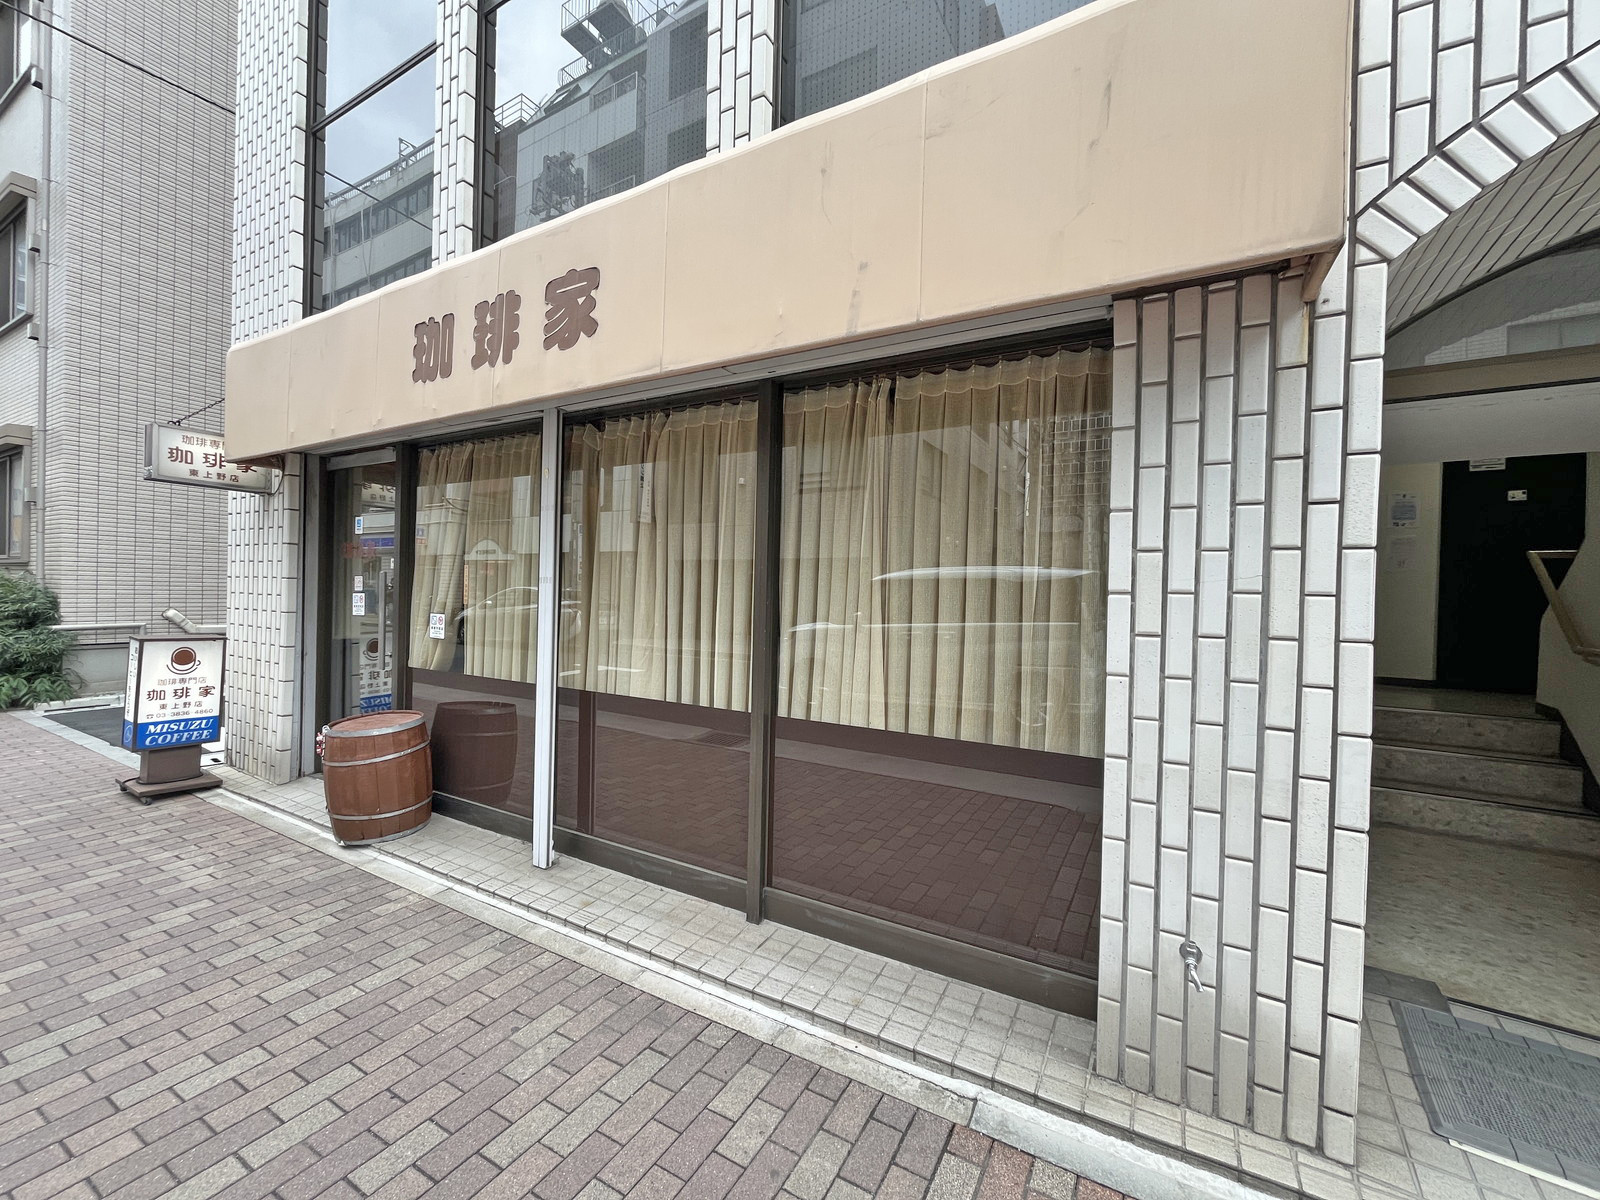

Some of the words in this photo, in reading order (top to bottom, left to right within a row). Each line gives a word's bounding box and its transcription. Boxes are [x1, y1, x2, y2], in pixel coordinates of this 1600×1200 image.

[412, 266, 600, 384] 珈琲家
[181, 434, 225, 450] 珈琲専
[189, 468, 240, 483] 東上野店
[146, 685, 216, 702] 珈琲家
[159, 702, 202, 710] 東上野店
[145, 719, 214, 735] MISUZU
[145, 729, 213, 746] COFFEE
